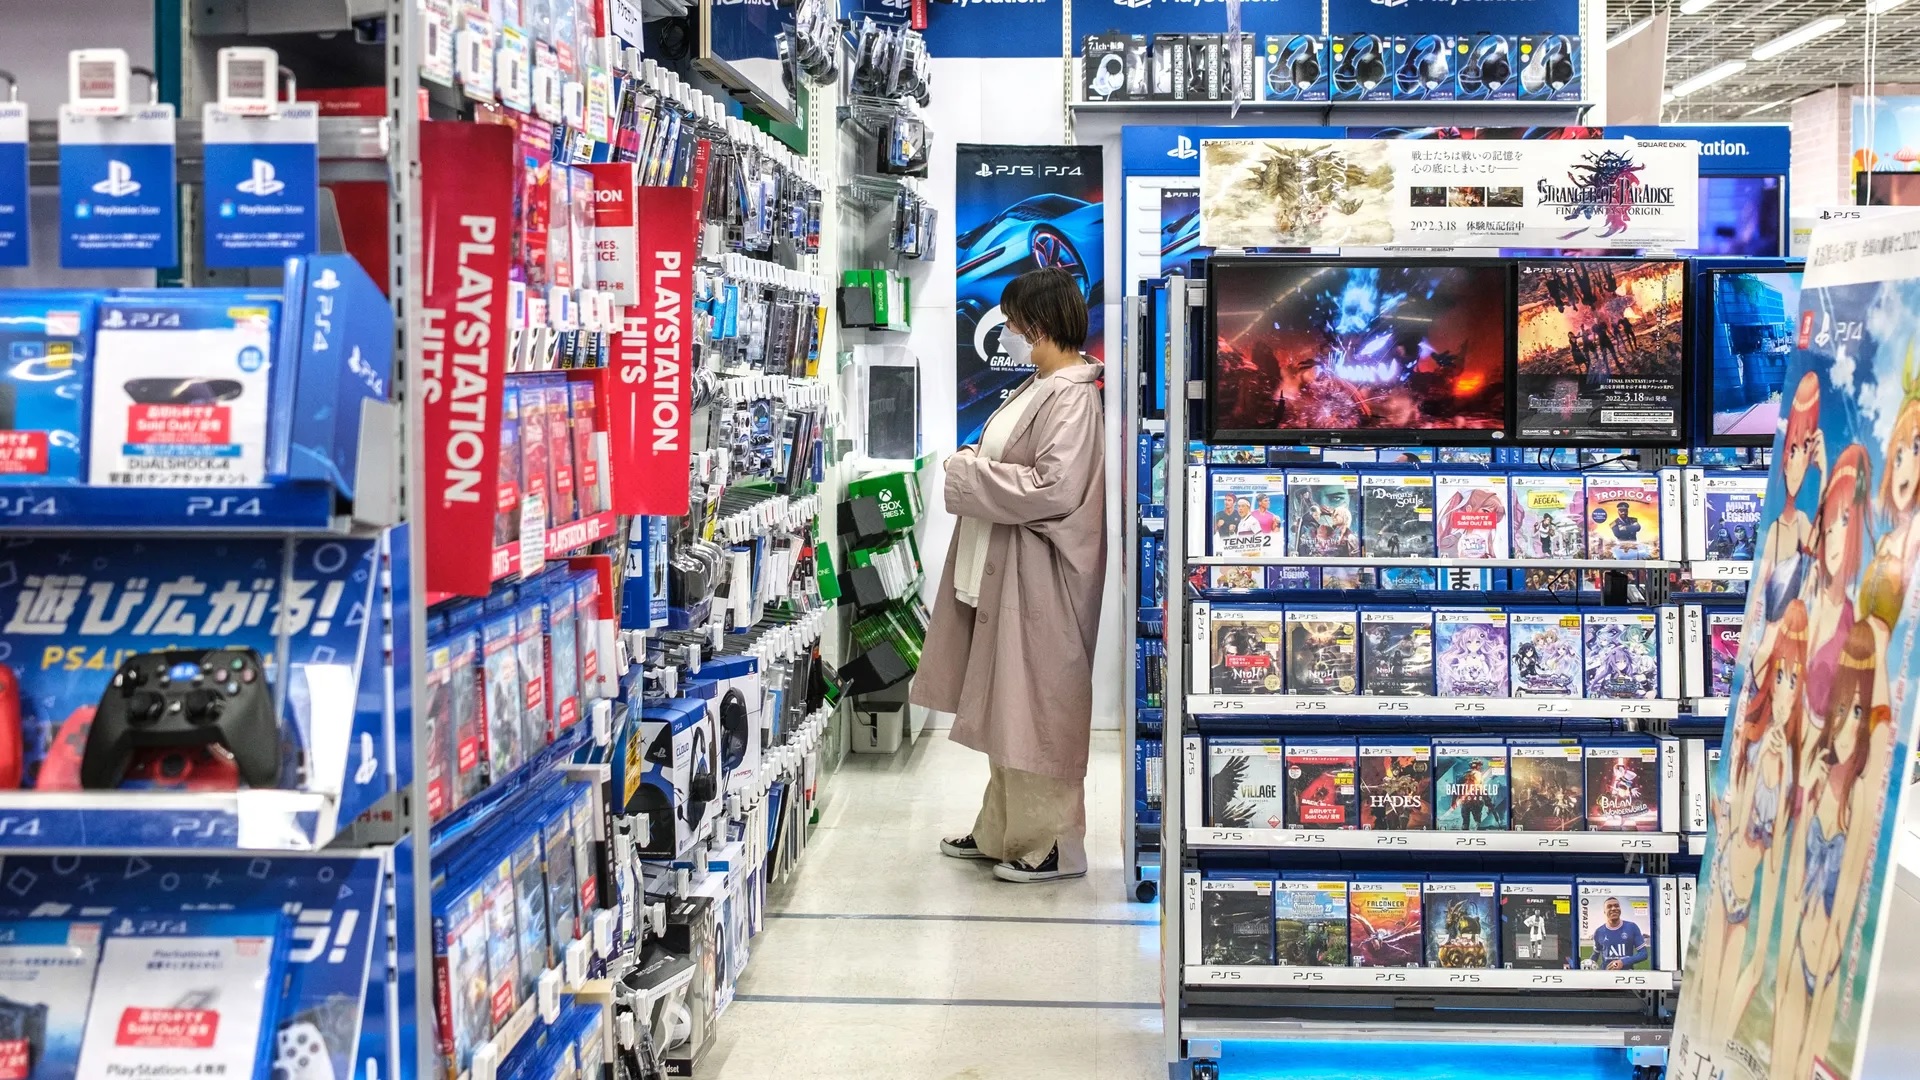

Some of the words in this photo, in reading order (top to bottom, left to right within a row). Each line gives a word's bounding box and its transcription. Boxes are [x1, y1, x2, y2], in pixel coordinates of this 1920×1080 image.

[1411, 150, 1523, 161] 戦士たちは戦いの記憶を
[996, 165, 1033, 176] PS5
[1045, 166, 1083, 176] PS4
[1537, 178, 1597, 207] STRANGER
[1600, 184, 1617, 205] OF
[1618, 175, 1675, 206] PARADISE
[1628, 206, 1663, 216] ORIGIN
[1467, 220, 1524, 232] 体験版配信中
[130, 314, 182, 327] PS4
[1834, 321, 1863, 342] PS4
[621, 316, 648, 385] HITS
[652, 250, 681, 451] PLAYSTATION
[421, 309, 447, 404] HITS
[444, 215, 497, 503] PLAYSTATION
[1595, 490, 1643, 502] TROPICO
[186, 497, 264, 517] PS4
[1395, 497, 1424, 508] Souls
[1722, 512, 1761, 523] LEGENDS
[1223, 536, 1262, 546] TENNIS
[1262, 535, 1272, 547] 2
[1718, 566, 1749, 575] PS5
[1213, 701, 1244, 709] PS5
[1296, 701, 1326, 710] PS5
[1378, 702, 1409, 711] PS5
[1455, 703, 1485, 711] PS5
[1620, 704, 1651, 713] PS5
[1446, 784, 1498, 796] BATTLEFIELD
[1369, 793, 1422, 811] HADES
[1601, 795, 1632, 809] BALAN
[1212, 832, 1243, 841] PS5
[1295, 834, 1325, 843] PS5
[1377, 836, 1408, 845] PS5
[1456, 838, 1487, 846] PS5
[1538, 838, 1569, 847] PS5
[1621, 840, 1652, 848] PS5
[138, 920, 189, 934] PS4
[1211, 971, 1241, 980] PS5
[1293, 972, 1323, 981] PS5
[1375, 973, 1406, 982] PS5
[1450, 974, 1480, 983] PS5
[1532, 975, 1562, 984] PS5
[1615, 976, 1646, 985] PS5
